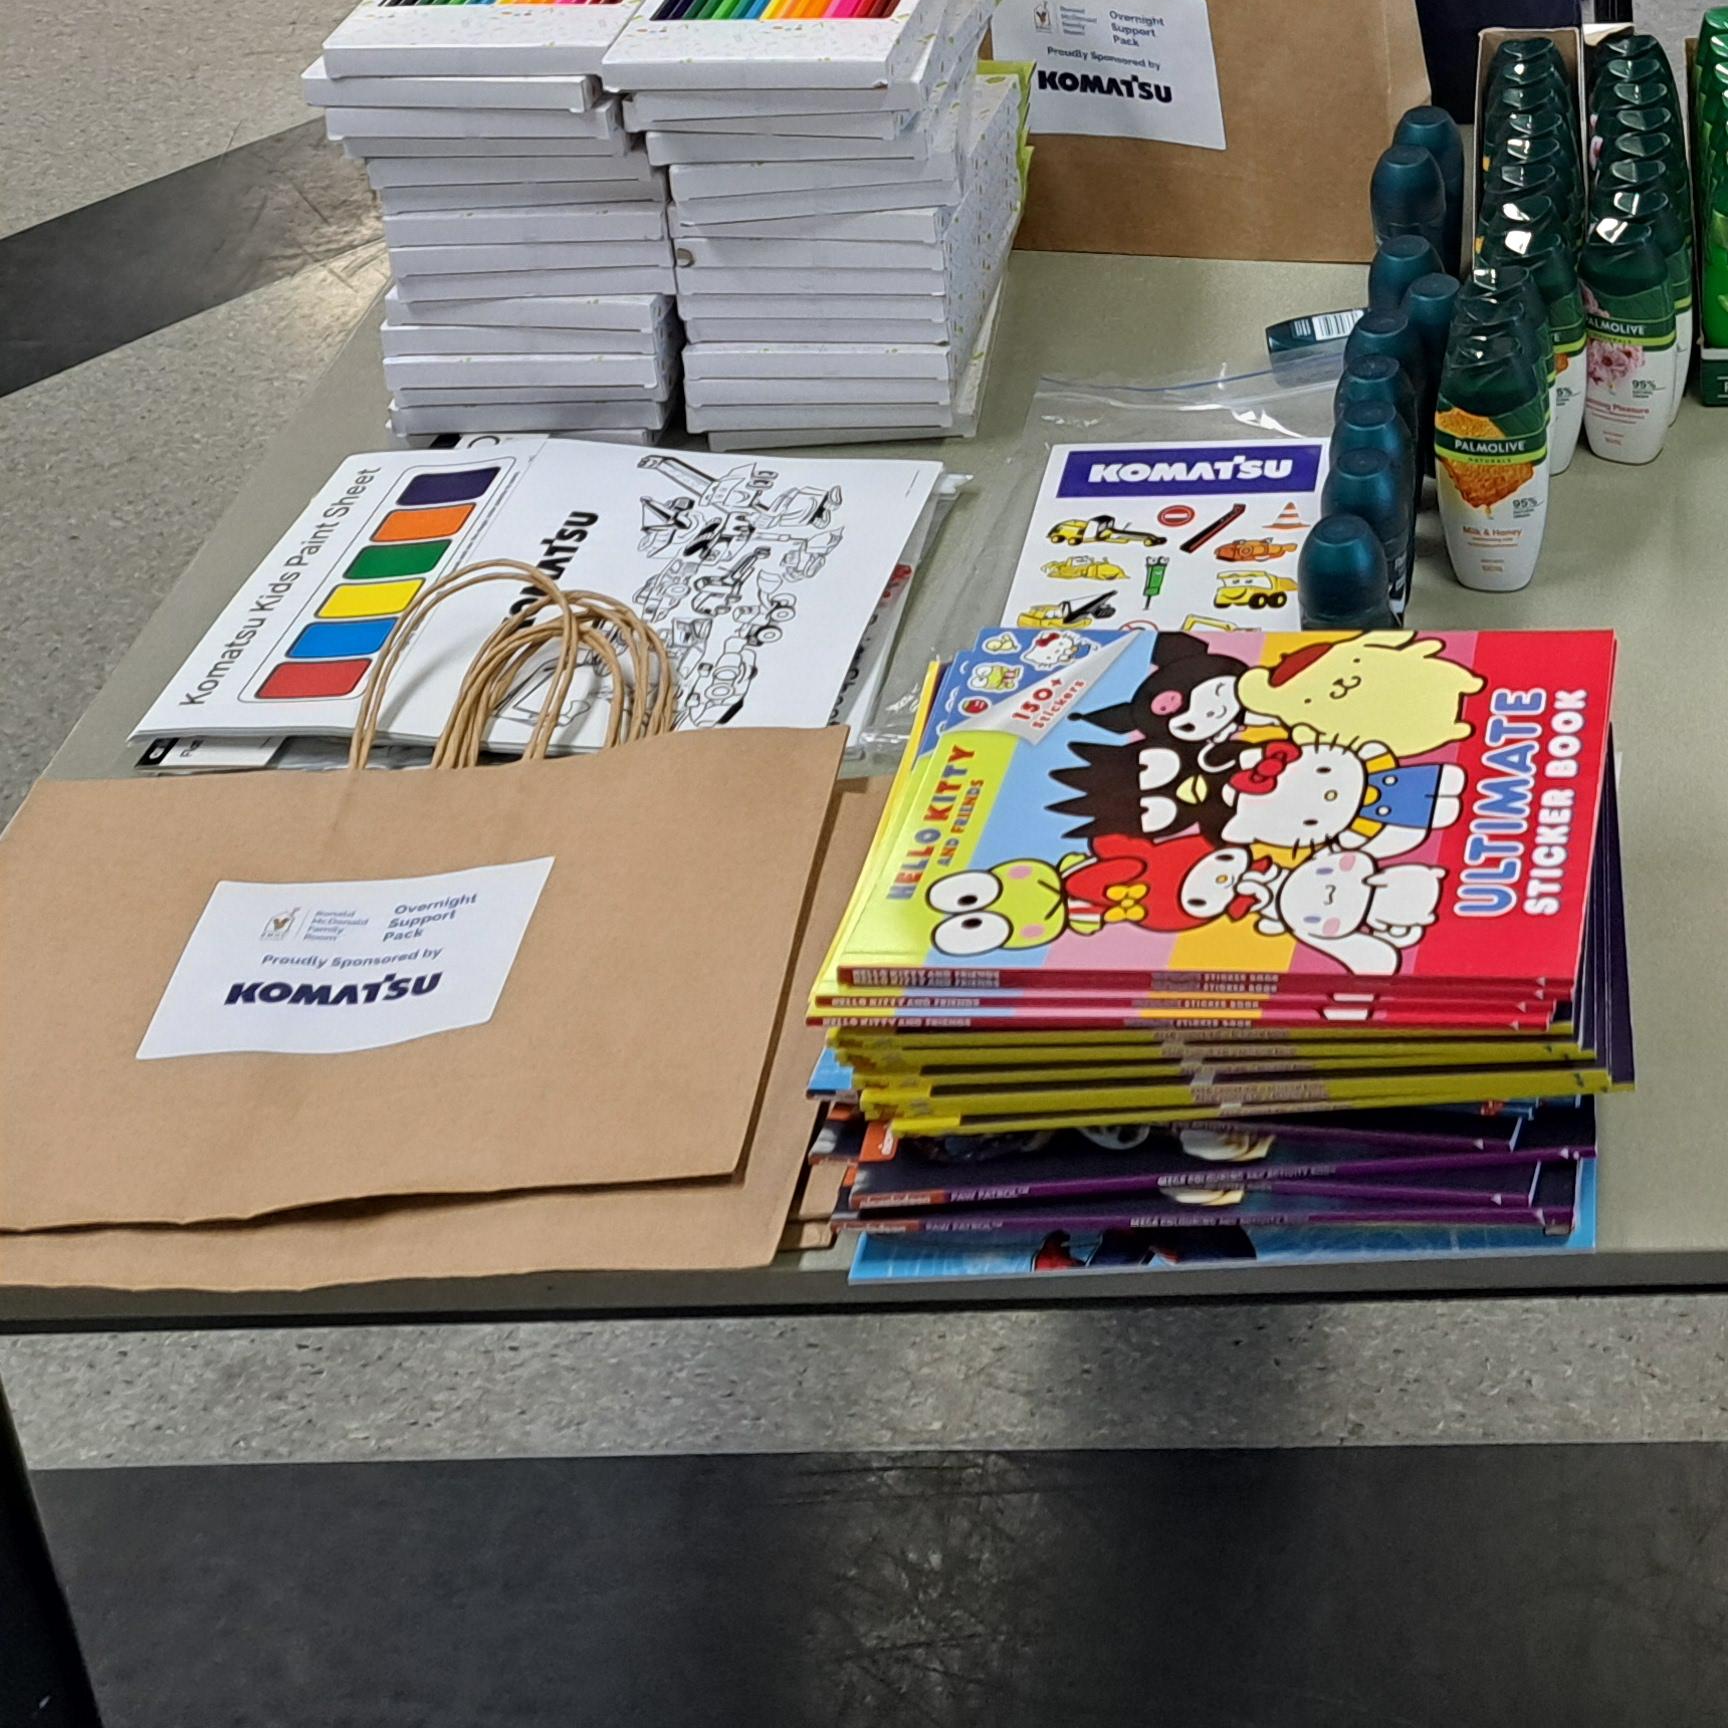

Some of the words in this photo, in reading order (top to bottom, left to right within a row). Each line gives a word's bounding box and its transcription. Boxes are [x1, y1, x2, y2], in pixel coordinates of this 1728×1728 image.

[1109, 10, 1165, 27] Overnight
[1111, 22, 1156, 38] Support
[1112, 35, 1139, 47] Pack
[1047, 46, 1088, 61] Proudly
[1090, 50, 1146, 68] Sponsored
[1148, 59, 1161, 71] by
[1037, 70, 1173, 103] KOMATSU
[1586, 315, 1645, 335] ALMOLIVE
[1632, 379, 1656, 389] 95%
[1454, 439, 1526, 453] PALMOLIVE
[1088, 455, 1294, 484] KOMATSU
[1513, 497, 1538, 509] 95%
[1462, 525, 1481, 537] Milk
[1483, 528, 1490, 537] &
[1494, 529, 1521, 538] Honey
[180, 615, 266, 706] Komatsu
[254, 568, 302, 613] Kids
[296, 520, 340, 568] Paint
[323, 466, 381, 519] Sheet
[1011, 676, 1064, 721] 150+
[1032, 679, 1086, 729] Stickers
[1546, 688, 1587, 778] BOOK
[1453, 687, 1548, 917] ULTIMATE
[886, 828, 941, 900] HELLO
[924, 745, 976, 823] KITTY
[937, 836, 962, 868] AND
[951, 778, 985, 834] FRIENDS
[1524, 788, 1575, 915] STICKER
[394, 892, 478, 915] Overnight
[387, 910, 456, 931] Support
[382, 927, 424, 943] Pack
[261, 953, 330, 969] Proudly
[330, 950, 420, 970] Sponsored
[422, 946, 444, 961] by
[223, 971, 444, 1007] KOMATSU
